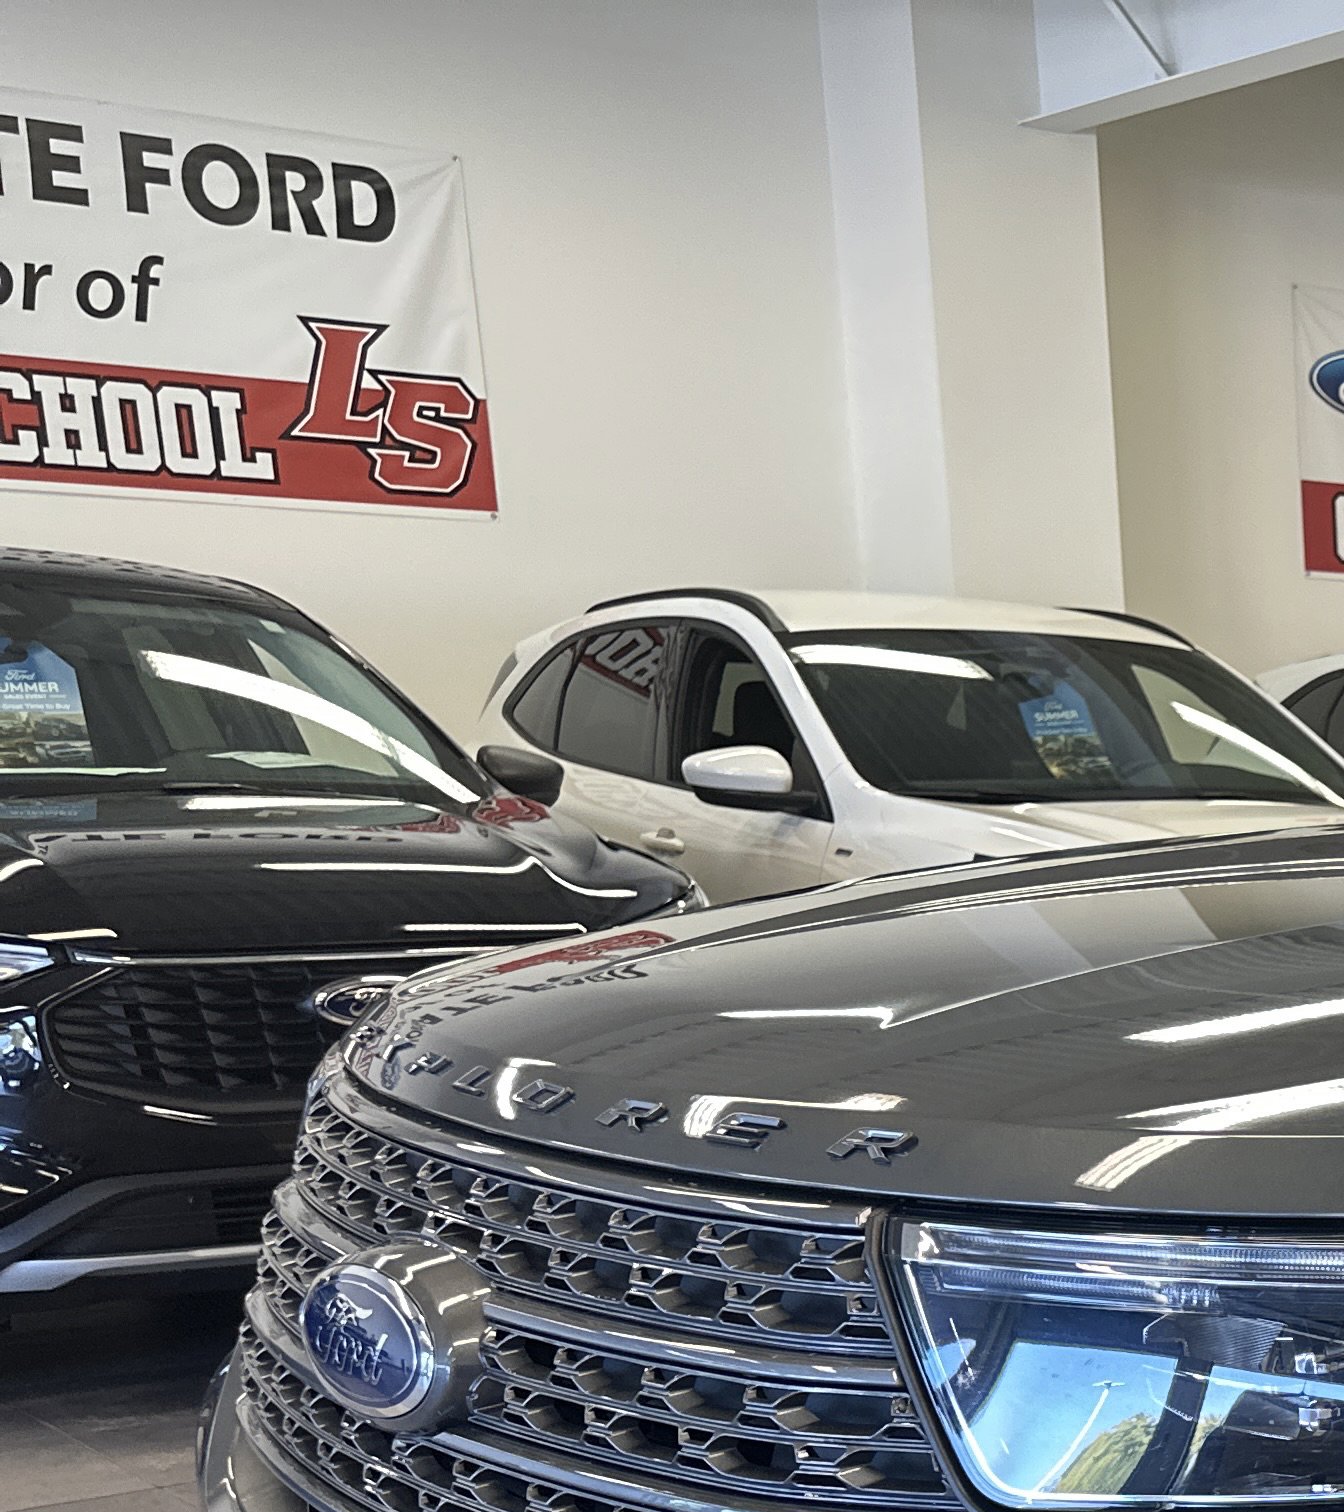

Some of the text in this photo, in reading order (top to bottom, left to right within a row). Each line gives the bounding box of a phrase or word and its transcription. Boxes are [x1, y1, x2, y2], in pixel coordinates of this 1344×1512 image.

[119, 131, 396, 243] FORD
[76, 255, 164, 322] of
[315, 1293, 392, 1386] Ford
